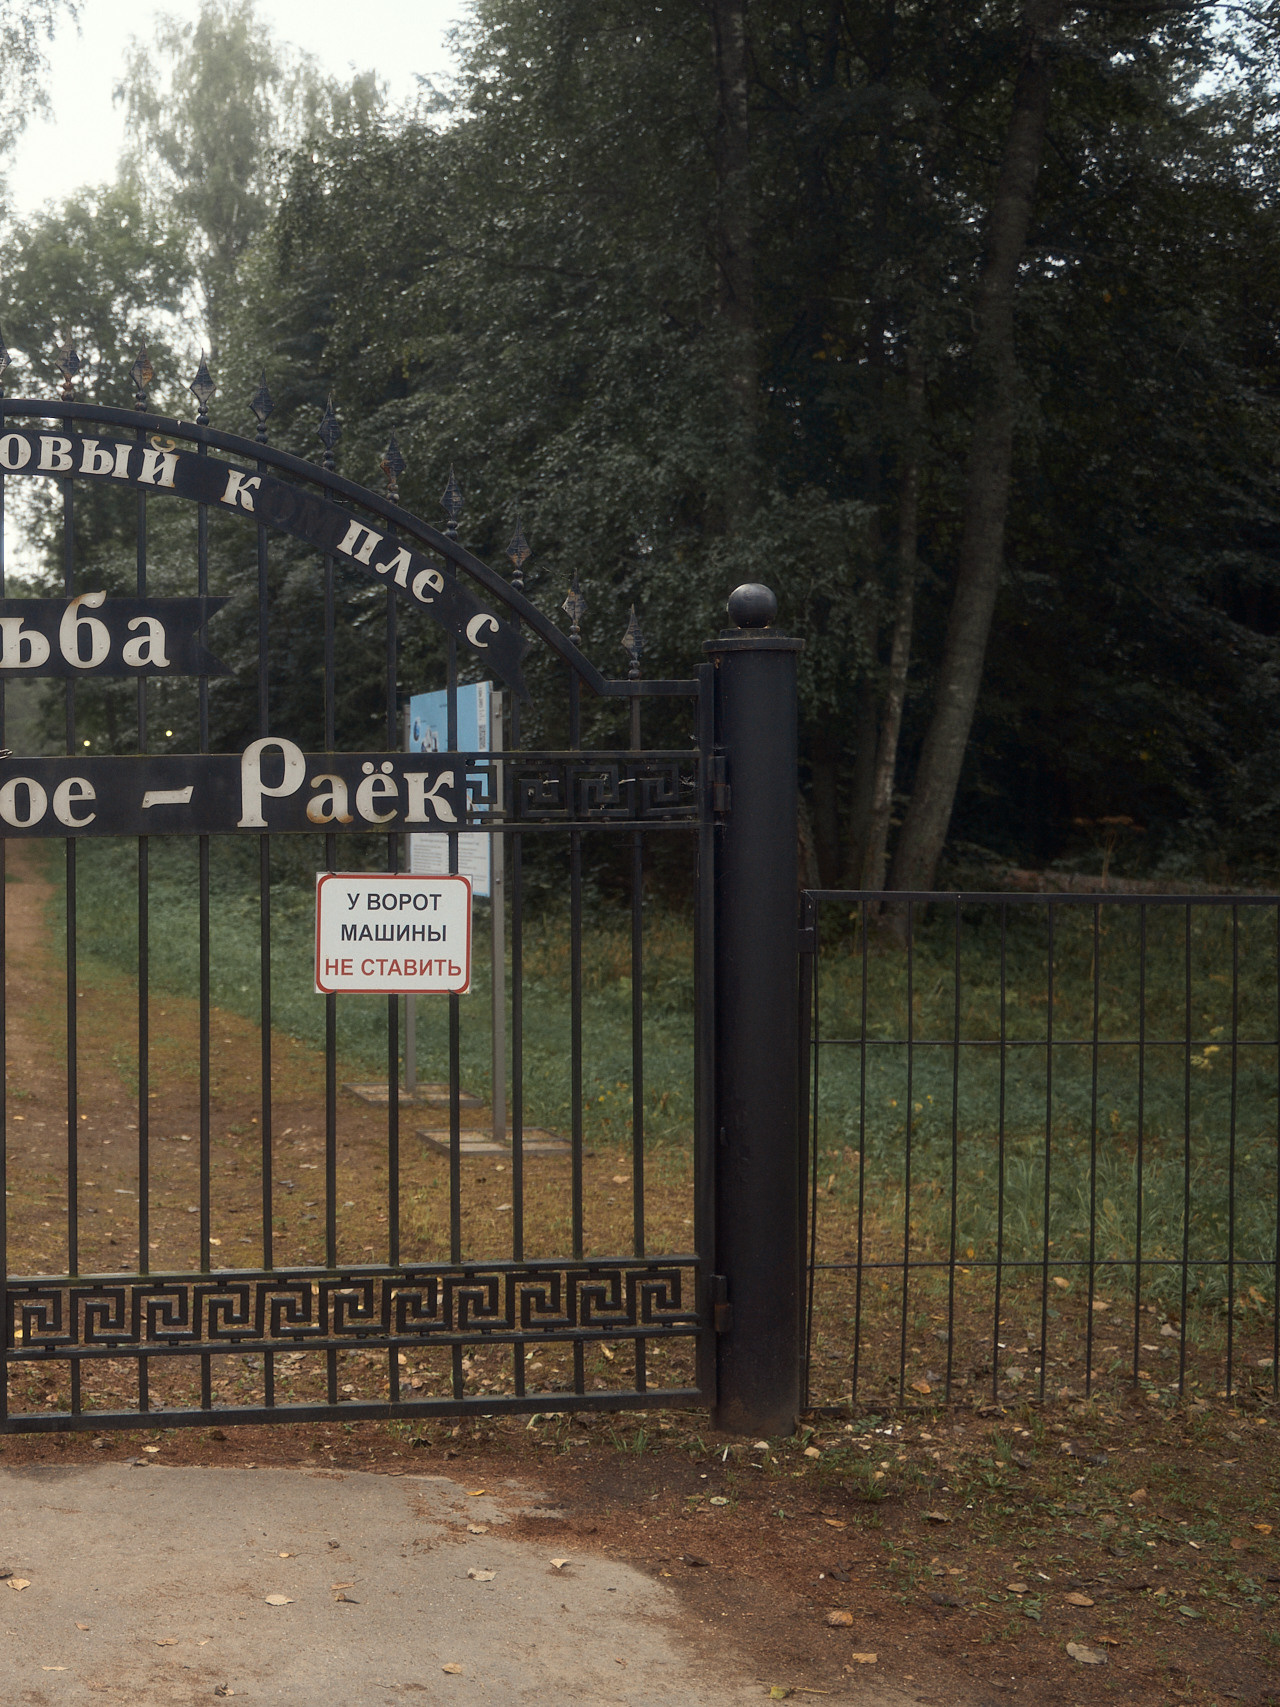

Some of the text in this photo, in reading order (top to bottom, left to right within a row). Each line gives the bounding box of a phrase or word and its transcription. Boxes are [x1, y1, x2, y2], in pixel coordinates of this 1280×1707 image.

[236, 736, 458, 828] Раёк
[347, 893, 442, 911] У ВОРОТ
[341, 924, 447, 942] МАШИНЫ
[325, 959, 462, 977] НЕ СТАВИТЬ
